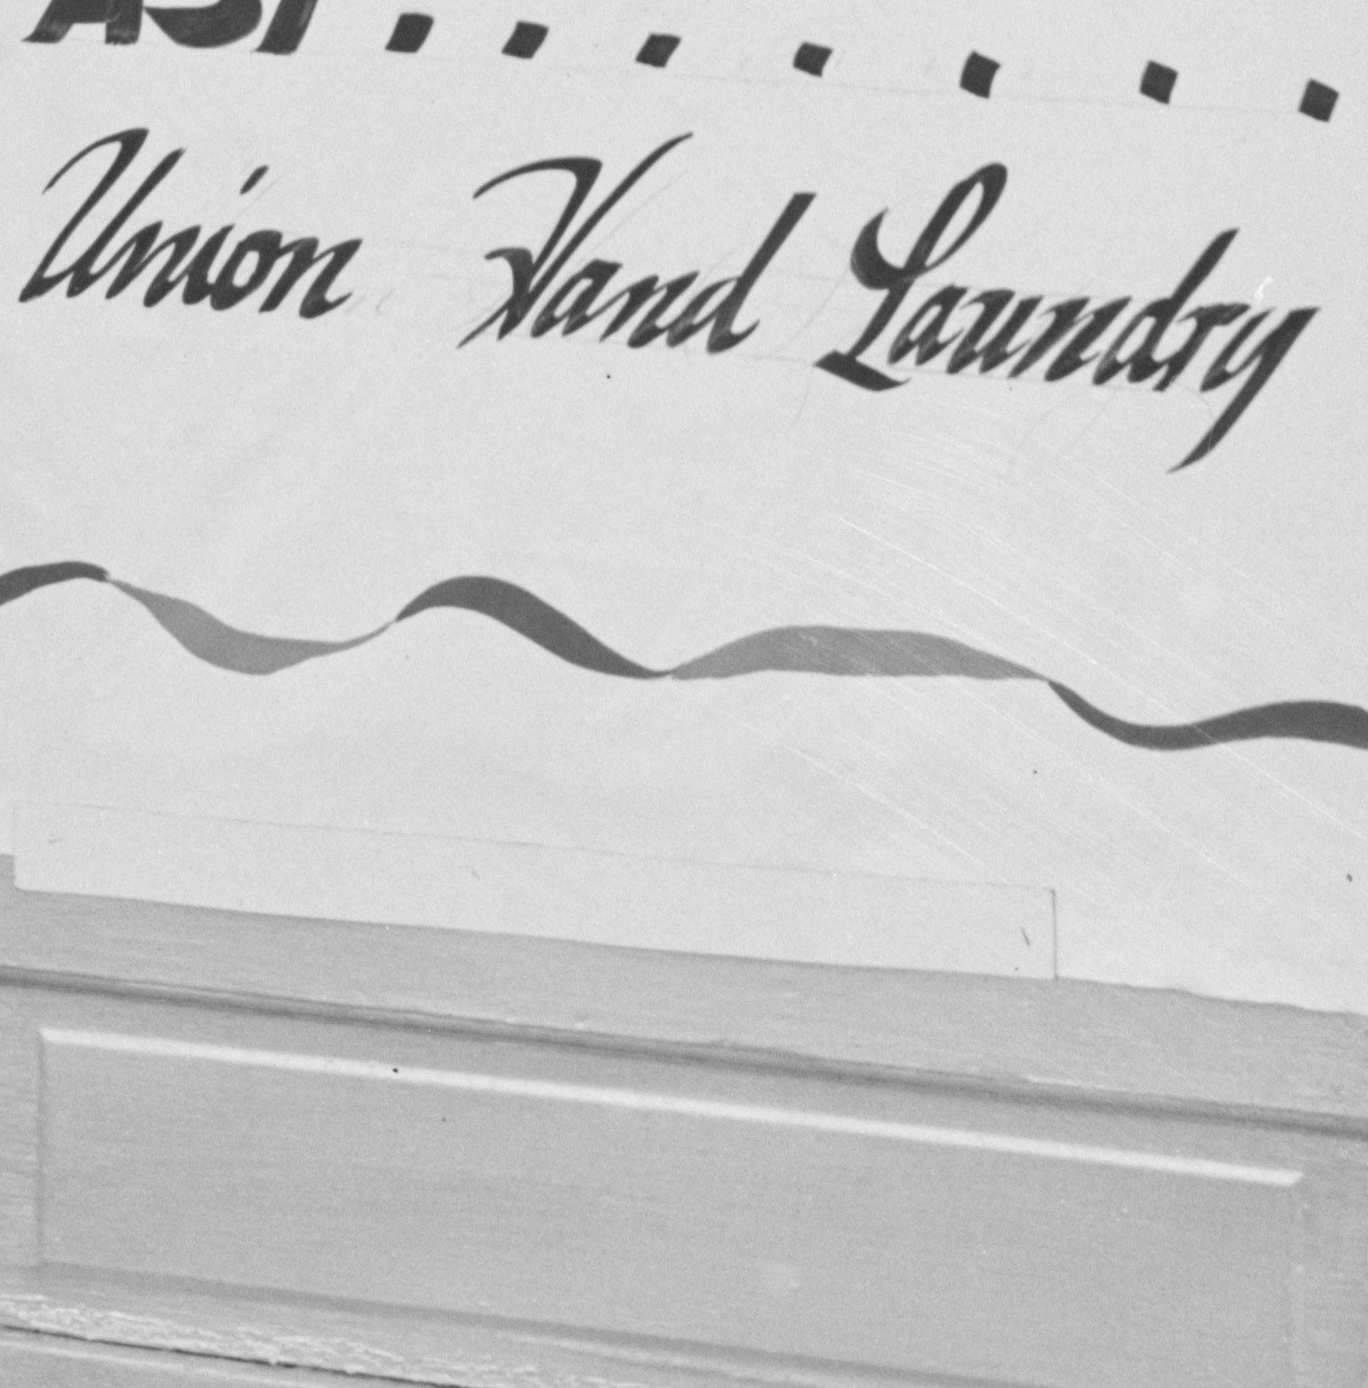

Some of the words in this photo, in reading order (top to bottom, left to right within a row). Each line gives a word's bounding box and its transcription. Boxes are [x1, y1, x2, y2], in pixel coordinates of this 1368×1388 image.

[17, 127, 363, 320] Union
[459, 132, 816, 354] Hand
[815, 162, 1318, 469] Laundry
